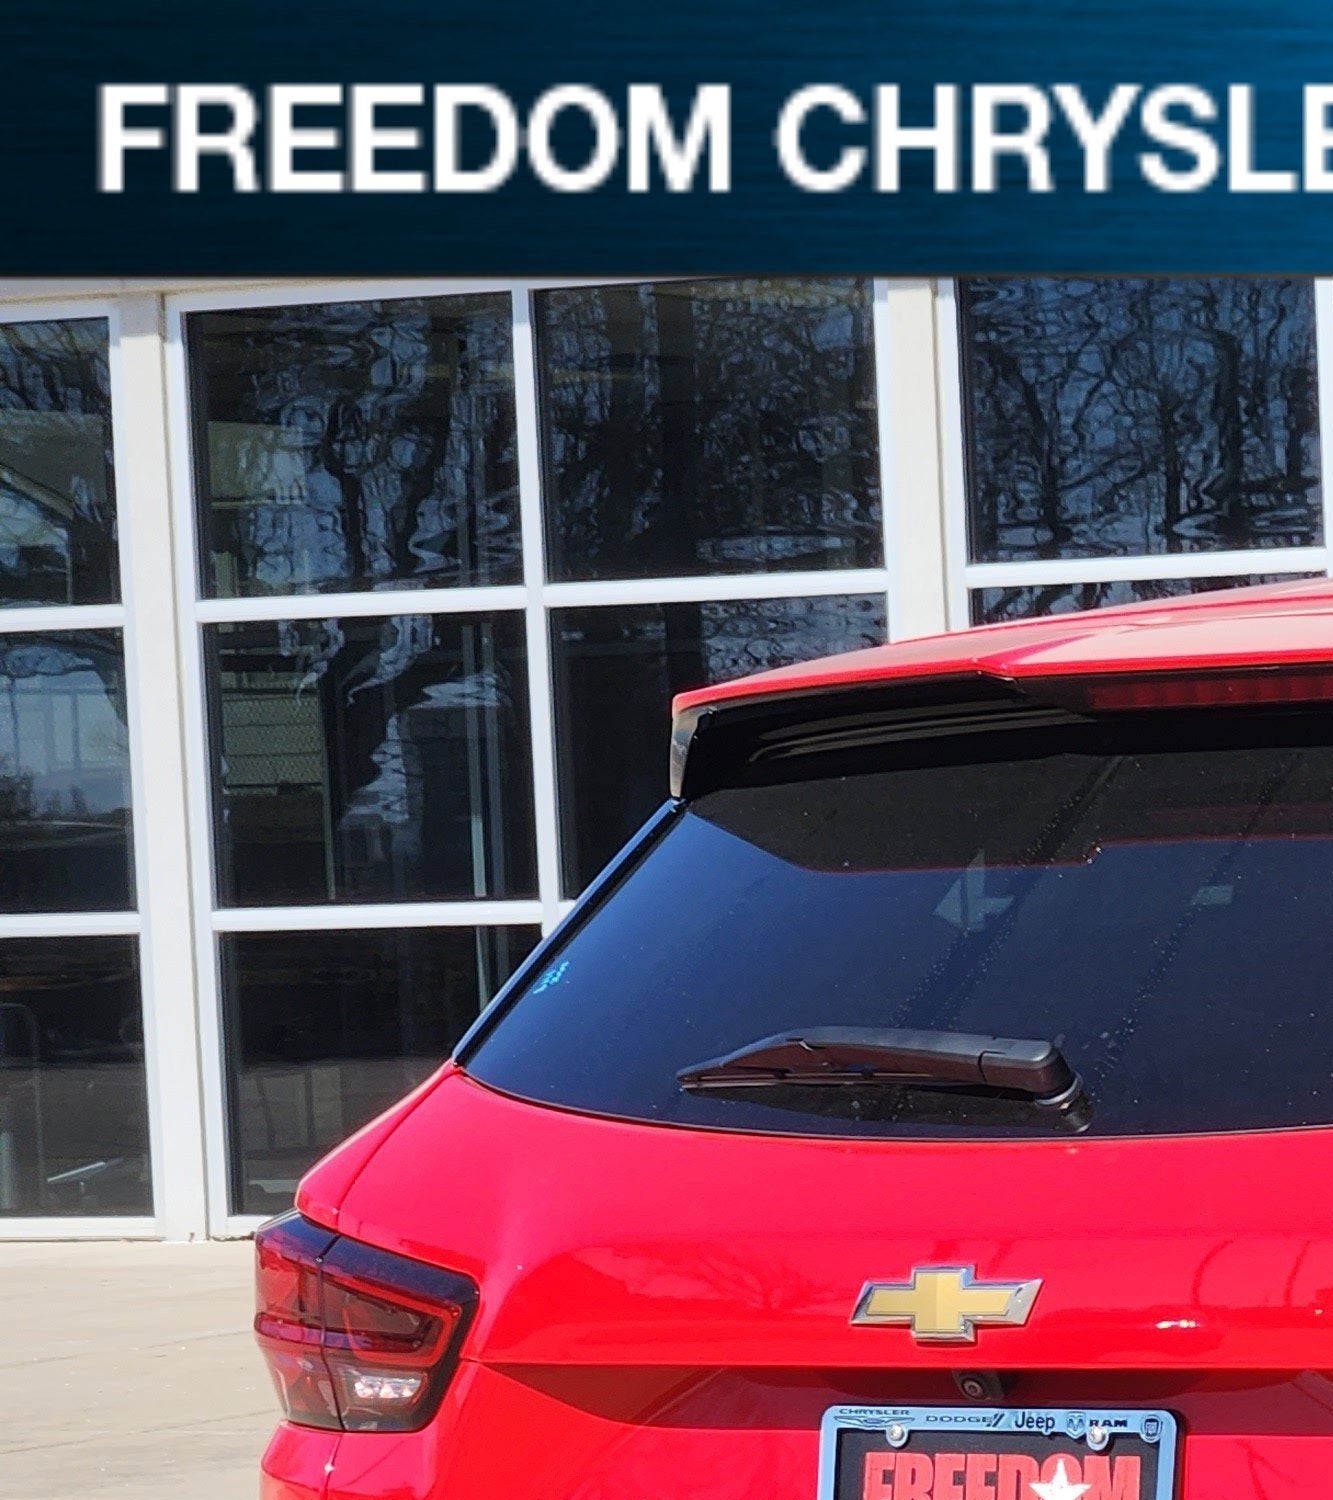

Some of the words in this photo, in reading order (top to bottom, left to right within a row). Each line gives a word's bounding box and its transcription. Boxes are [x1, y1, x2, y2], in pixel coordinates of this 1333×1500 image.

[839, 1408, 910, 1416] CHRYSLER
[925, 1415, 992, 1424] DODGE
[1014, 1411, 1056, 1433] Jeep
[1089, 1419, 1128, 1428] RAM
